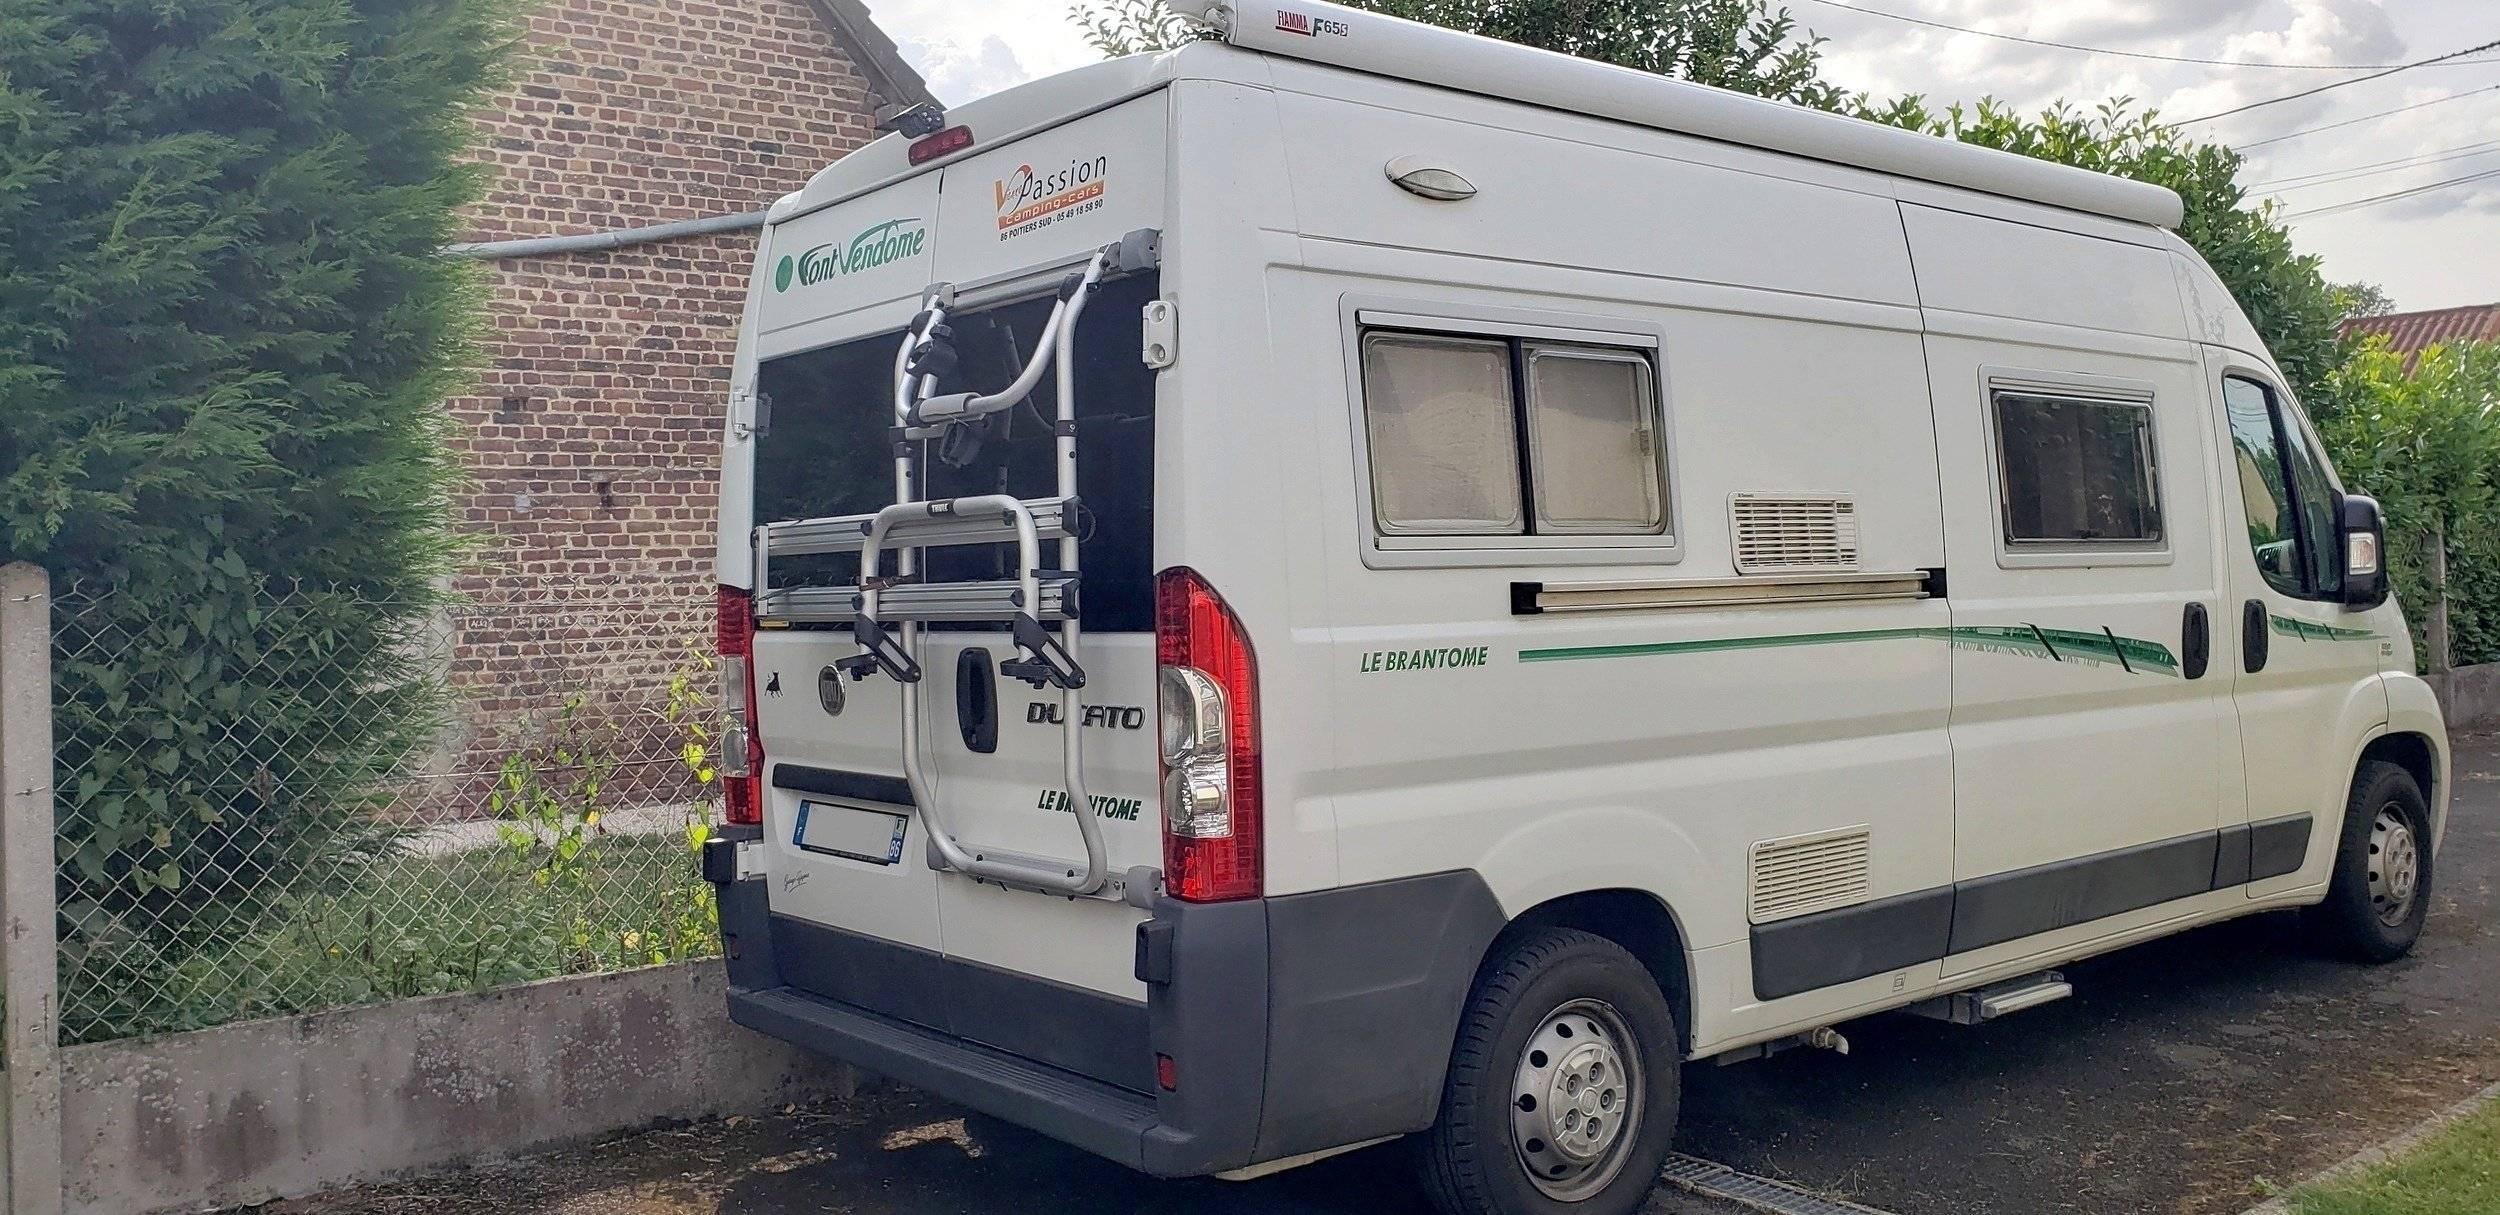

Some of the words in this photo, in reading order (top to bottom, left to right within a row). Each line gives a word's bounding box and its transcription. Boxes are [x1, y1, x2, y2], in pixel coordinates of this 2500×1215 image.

[1006, 184, 1099, 225] camping-cars
[1009, 222, 1038, 239] POITIERS
[1038, 215, 1052, 229] SUD
[1056, 211, 1065, 222] 05
[1076, 204, 1084, 215] 18
[1095, 198, 1103, 209] 90
[1360, 652, 1382, 673] LE
[1384, 646, 1489, 672] BRANTOME
[1027, 702, 1146, 730] DUATO
[1037, 789, 1057, 811] LE
[1055, 791, 1143, 822] BRNTOME
[889, 840, 901, 858] 86
